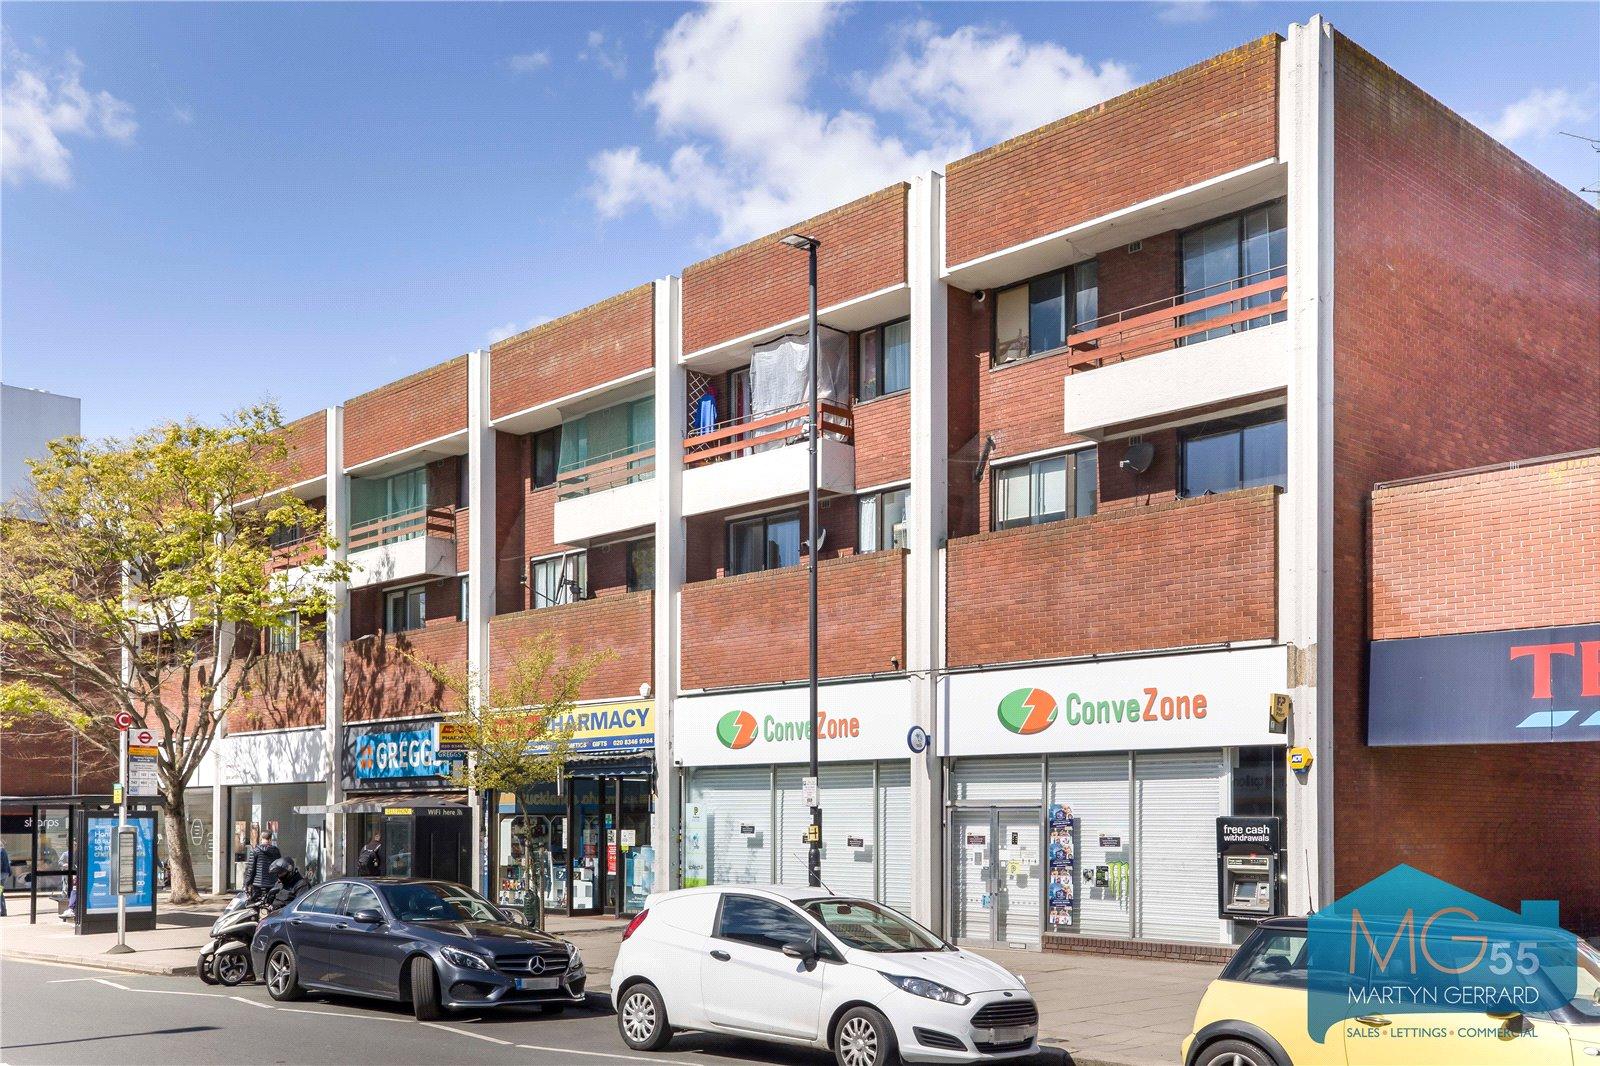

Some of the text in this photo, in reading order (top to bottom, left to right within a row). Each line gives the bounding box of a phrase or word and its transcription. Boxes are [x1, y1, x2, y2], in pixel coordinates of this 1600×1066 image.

[1066, 687, 1208, 726] ConveZone
[118, 713, 130, 726] C
[592, 740, 608, 748] GIFTS
[376, 739, 442, 769] GREGG
[438, 751, 463, 759] GREGGS
[443, 808, 456, 816] here
[1223, 824, 1270, 834] free cash
[1223, 833, 1270, 842] withdrawals
